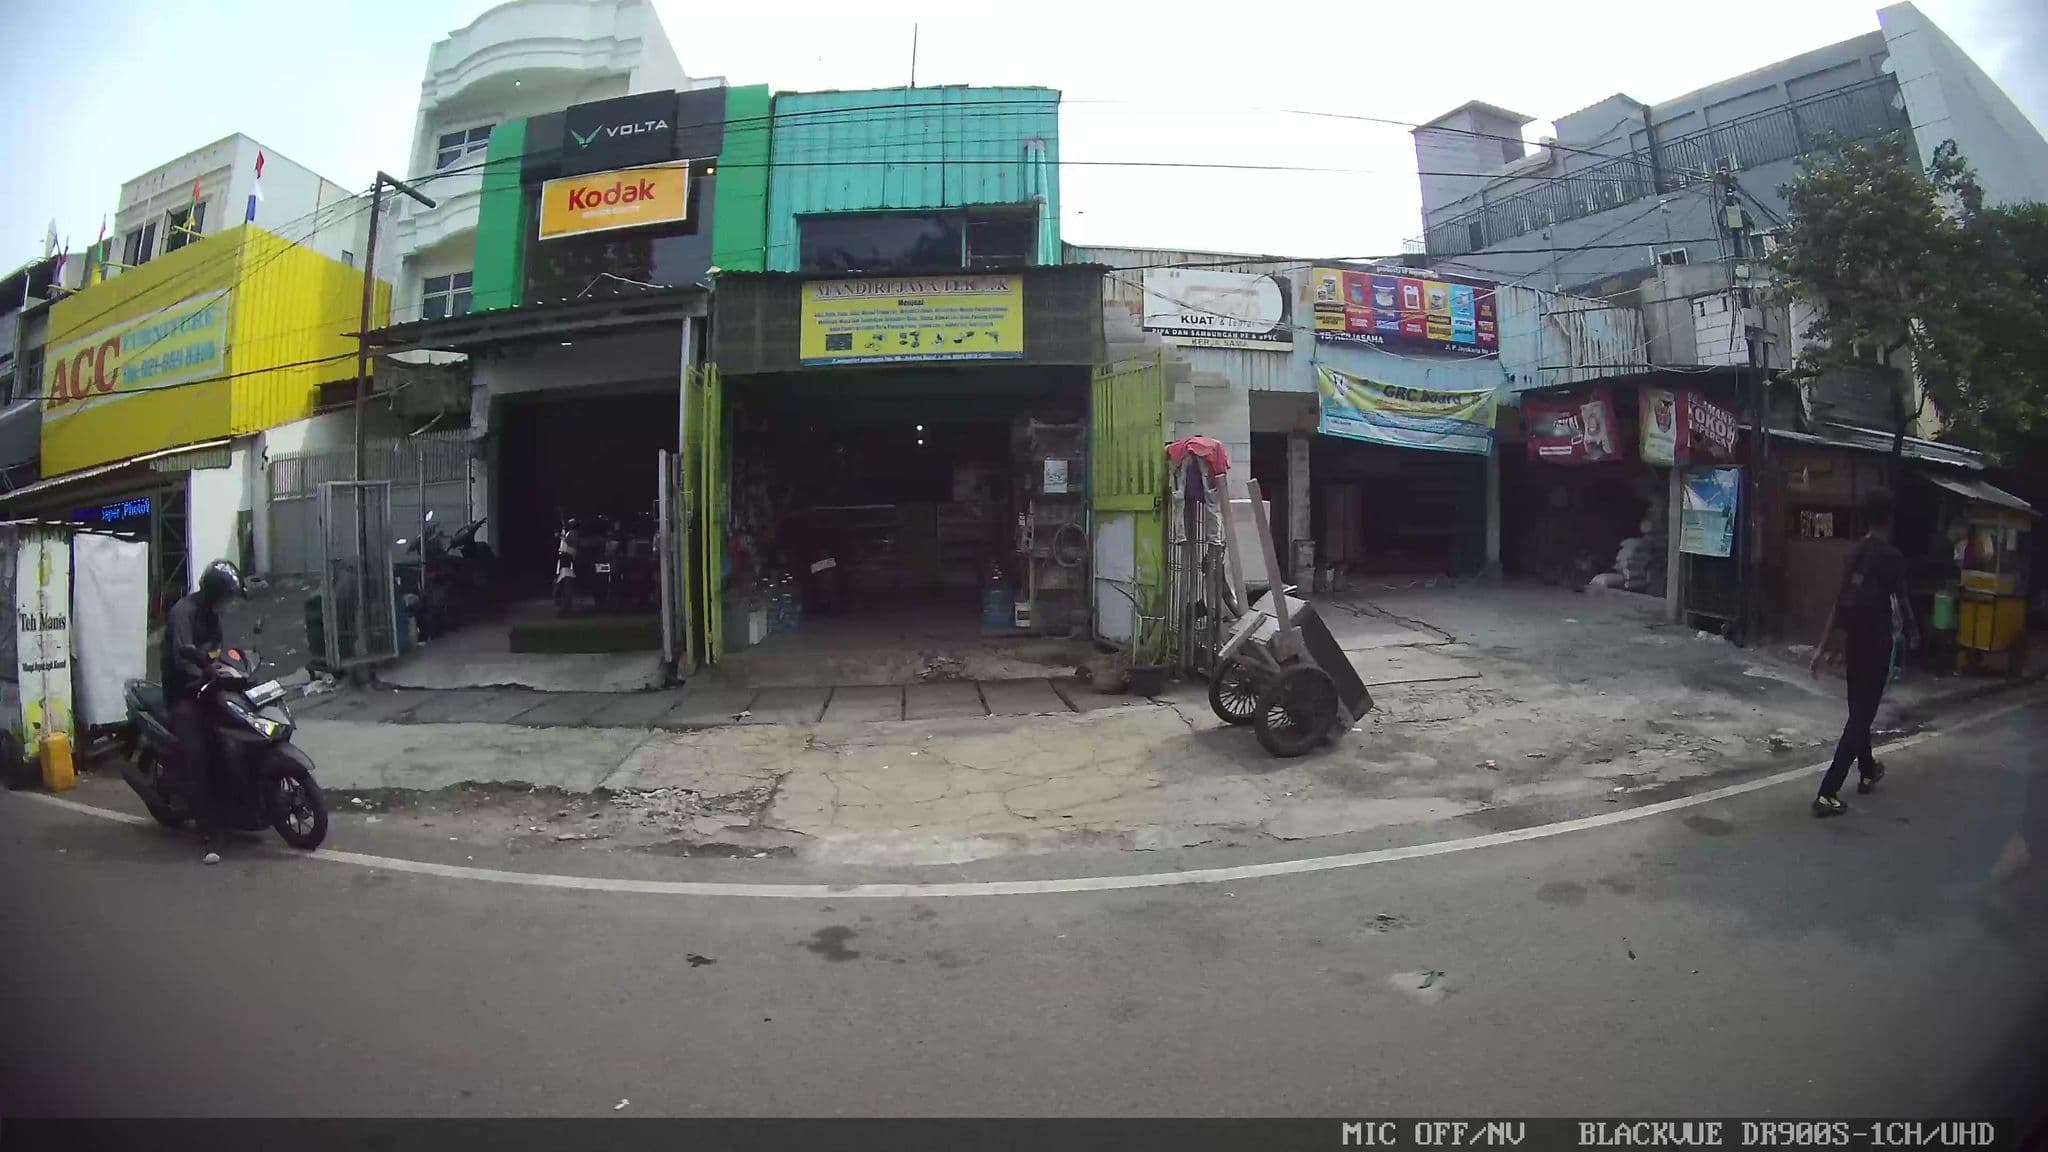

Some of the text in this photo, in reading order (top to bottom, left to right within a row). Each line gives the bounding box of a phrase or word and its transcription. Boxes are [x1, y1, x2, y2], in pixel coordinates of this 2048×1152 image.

[606, 119, 669, 137] VOLTA
[568, 178, 656, 212] Kodak
[816, 277, 1009, 296] MANDIRI JAYA TEKK
[1180, 315, 1215, 325] KUAT
[1172, 328, 1188, 336] DAN
[1191, 329, 1238, 339] SAMBUNGAN
[46, 335, 121, 411] ACC
[1383, 385, 1418, 402] GRC
[19, 611, 66, 632] Teh Manis
